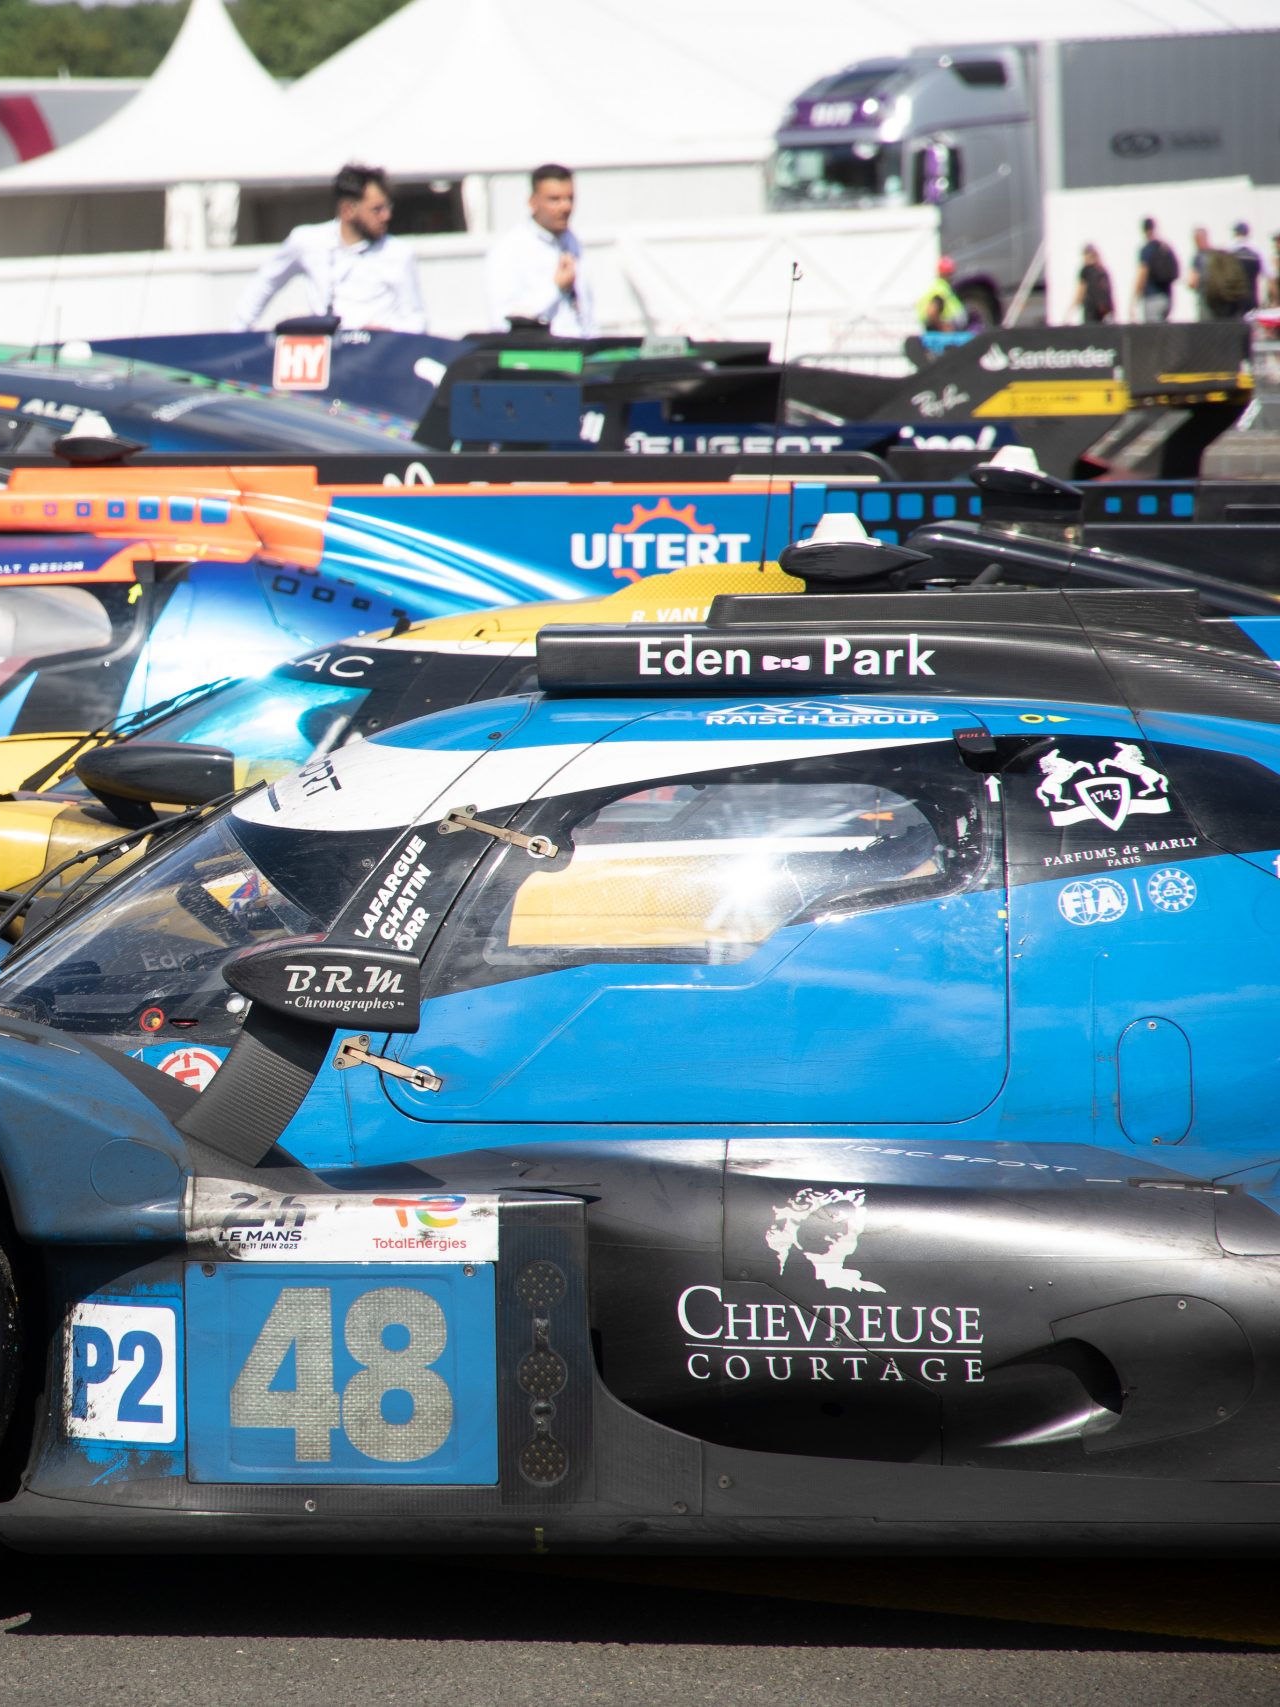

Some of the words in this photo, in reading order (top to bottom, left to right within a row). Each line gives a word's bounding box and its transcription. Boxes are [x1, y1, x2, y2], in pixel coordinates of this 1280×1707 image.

[279, 344, 325, 380] HY
[1008, 346, 1117, 369] Santander
[570, 533, 751, 570] UITERT
[28, 561, 85, 573] DESIGN
[656, 607, 699, 623] VAN
[639, 634, 751, 676] Eden
[825, 634, 936, 676] Park
[706, 714, 814, 726] RAISCH
[828, 713, 940, 725] GROUP
[1090, 789, 1121, 804] 1743
[1043, 848, 1117, 867] PARFUMS
[1123, 845, 1139, 855] de
[1145, 837, 1199, 853] MARLY
[1106, 855, 1141, 867] PARIS
[354, 834, 427, 939] LAFARGUE
[380, 863, 432, 940] CHATIN
[295, 996, 395, 1013] Chronographes
[842, 1145, 933, 1158] IDEC
[939, 1154, 1078, 1172] SPORT
[219, 1231, 245, 1242] LE
[246, 1230, 302, 1242] MANS
[259, 1243, 277, 1251] JUIN
[279, 1243, 298, 1251] 2023
[372, 1237, 467, 1252] TotalEnergies
[72, 1324, 163, 1424] P2
[230, 1287, 454, 1463] 48
[687, 1353, 985, 1382] COURTAGE
